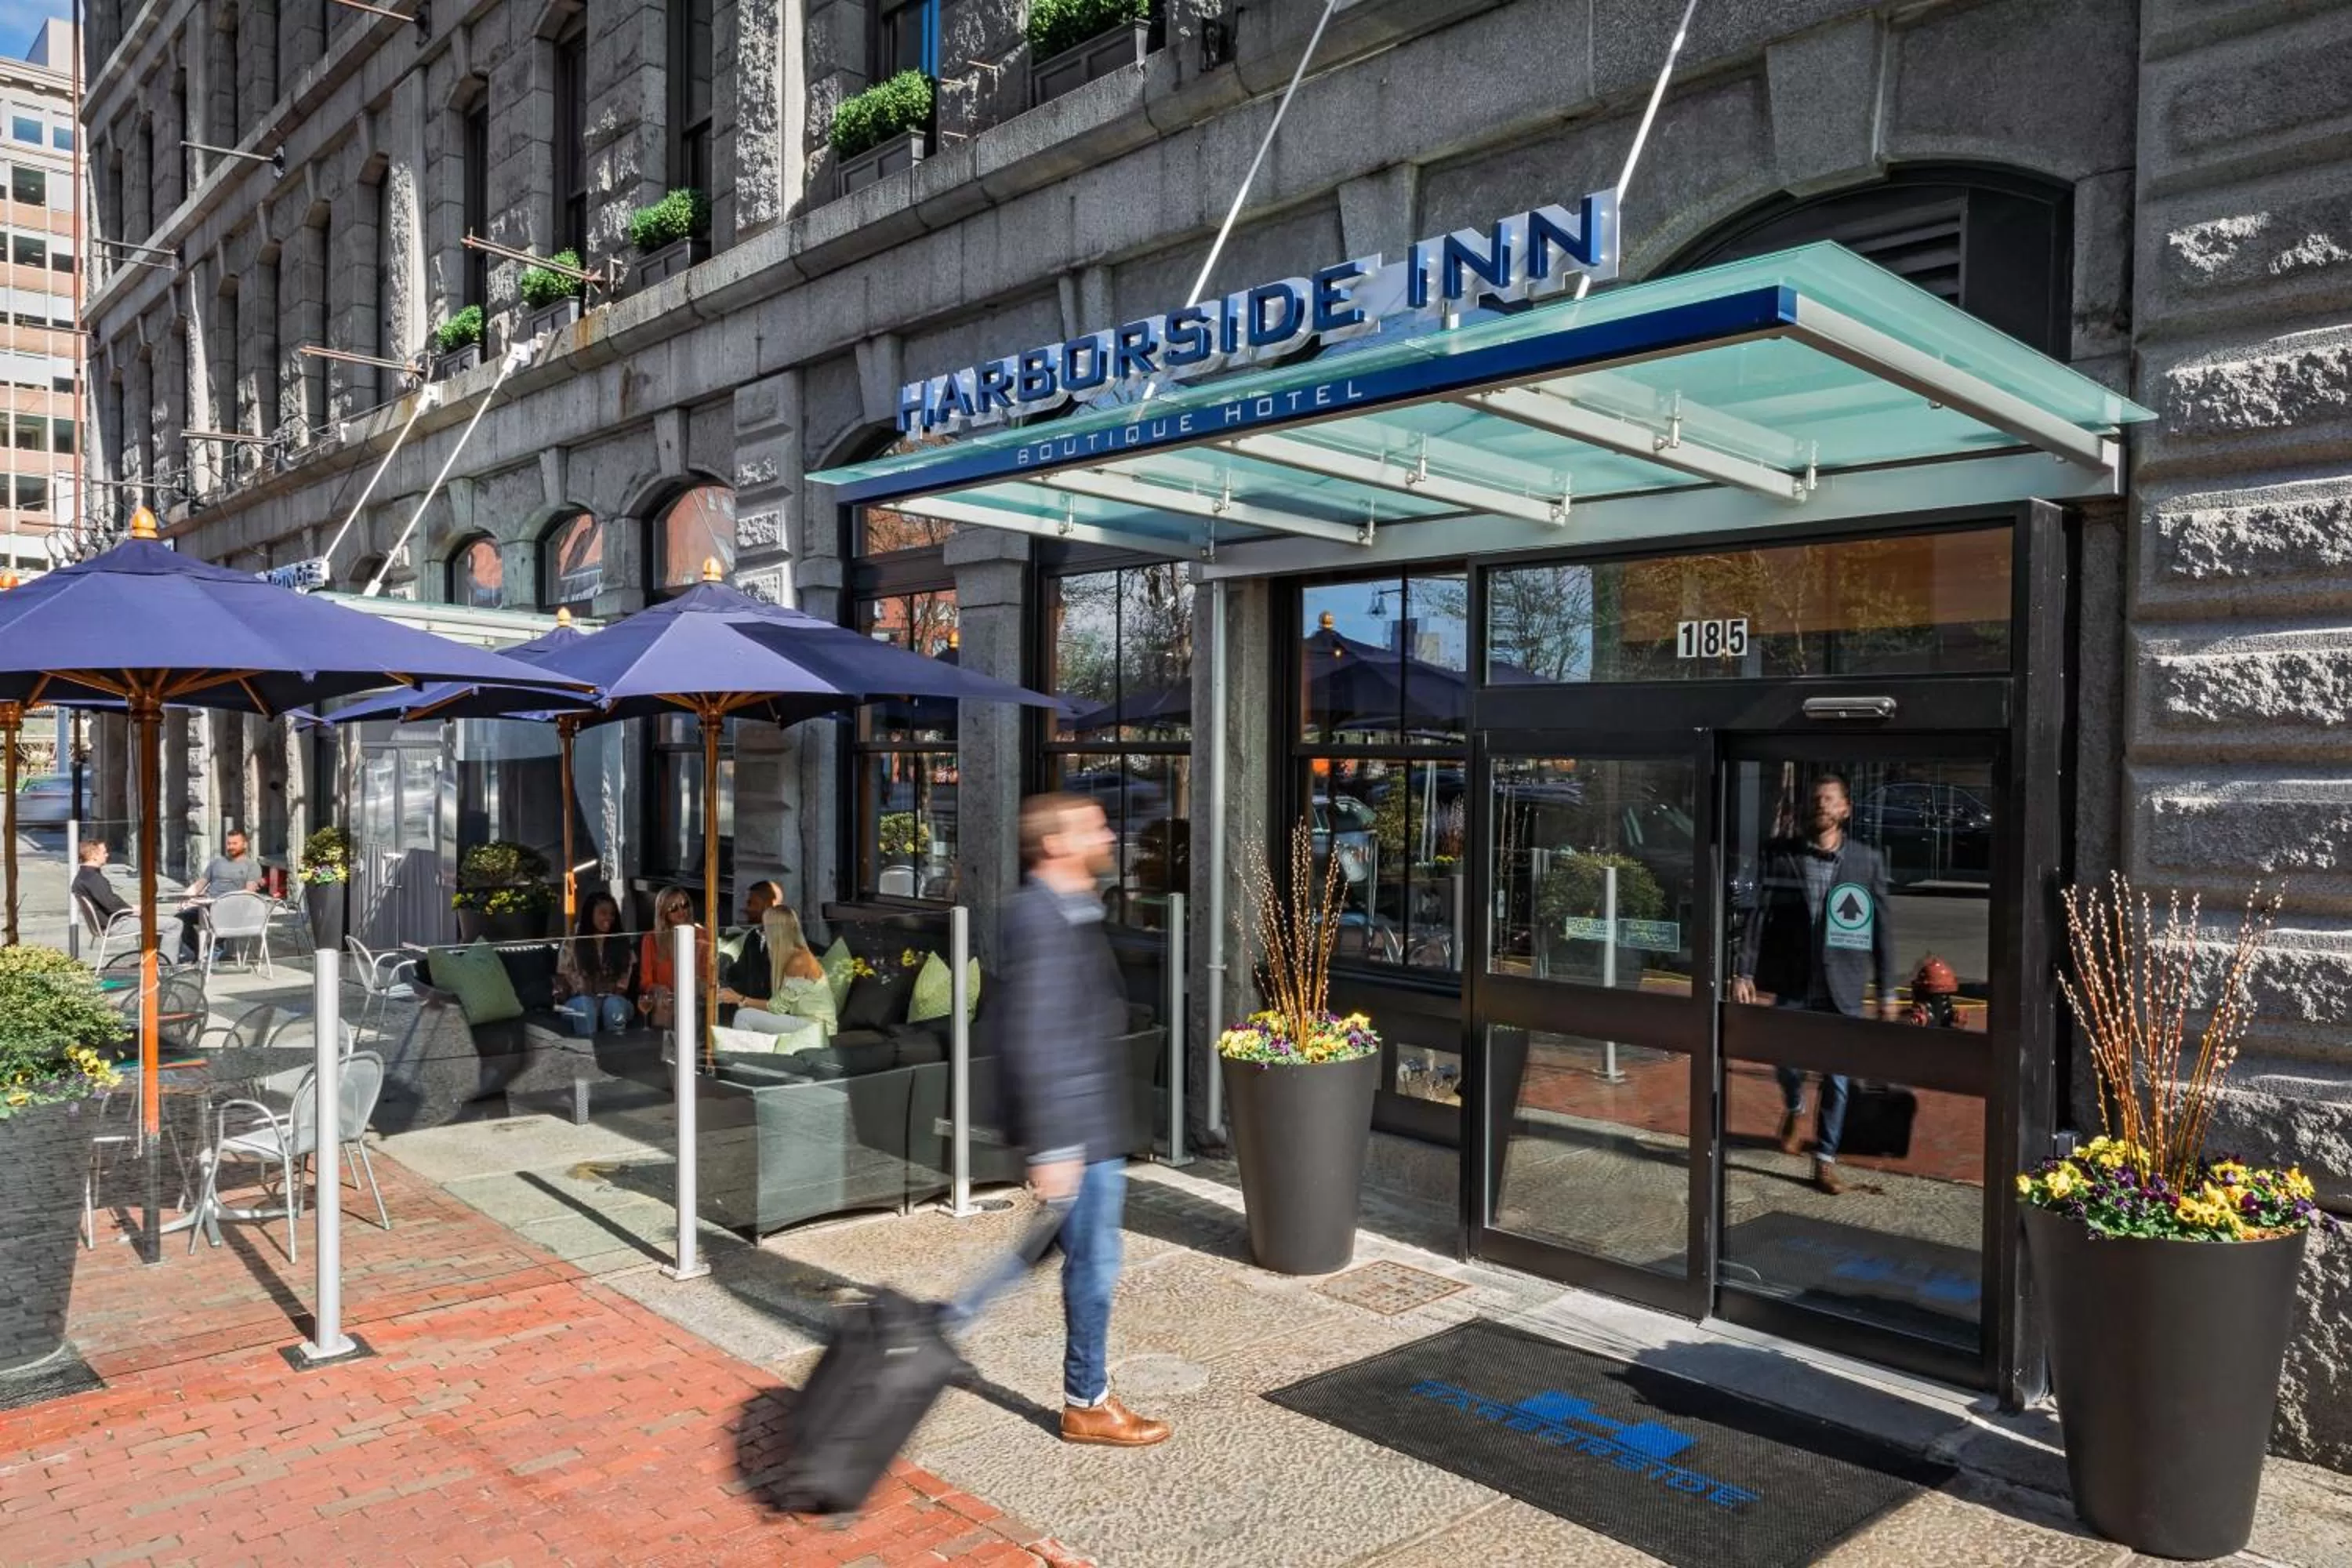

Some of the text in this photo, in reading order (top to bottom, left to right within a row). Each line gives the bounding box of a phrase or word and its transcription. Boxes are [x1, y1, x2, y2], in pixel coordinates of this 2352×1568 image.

[895, 196, 1601, 433] HARBORSIDE INN
[1018, 380, 1363, 465] BOUTIQUE HOTEL
[1682, 620, 1744, 656] 185
